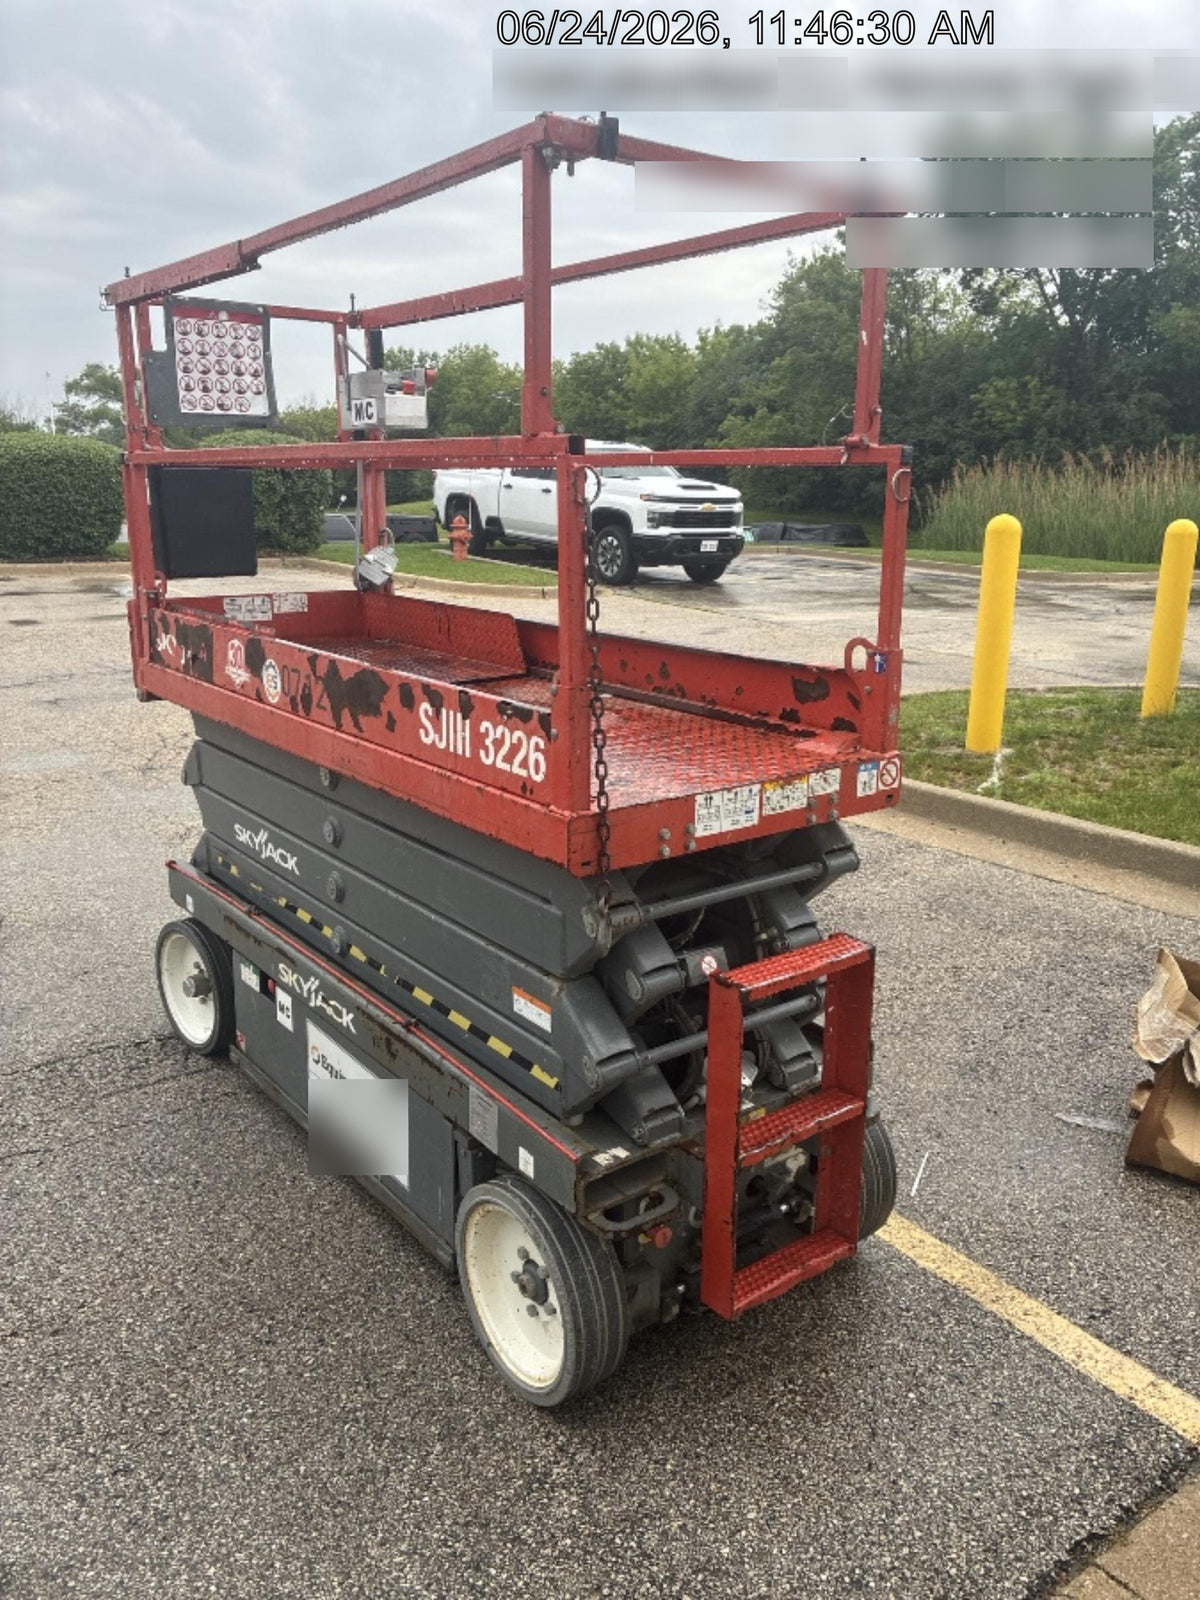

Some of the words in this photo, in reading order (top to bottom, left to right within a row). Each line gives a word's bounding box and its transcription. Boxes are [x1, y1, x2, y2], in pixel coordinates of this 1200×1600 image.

[353, 401, 374, 422] MC
[479, 720, 547, 783] 3226
[233, 823, 300, 877] SKYJACK
